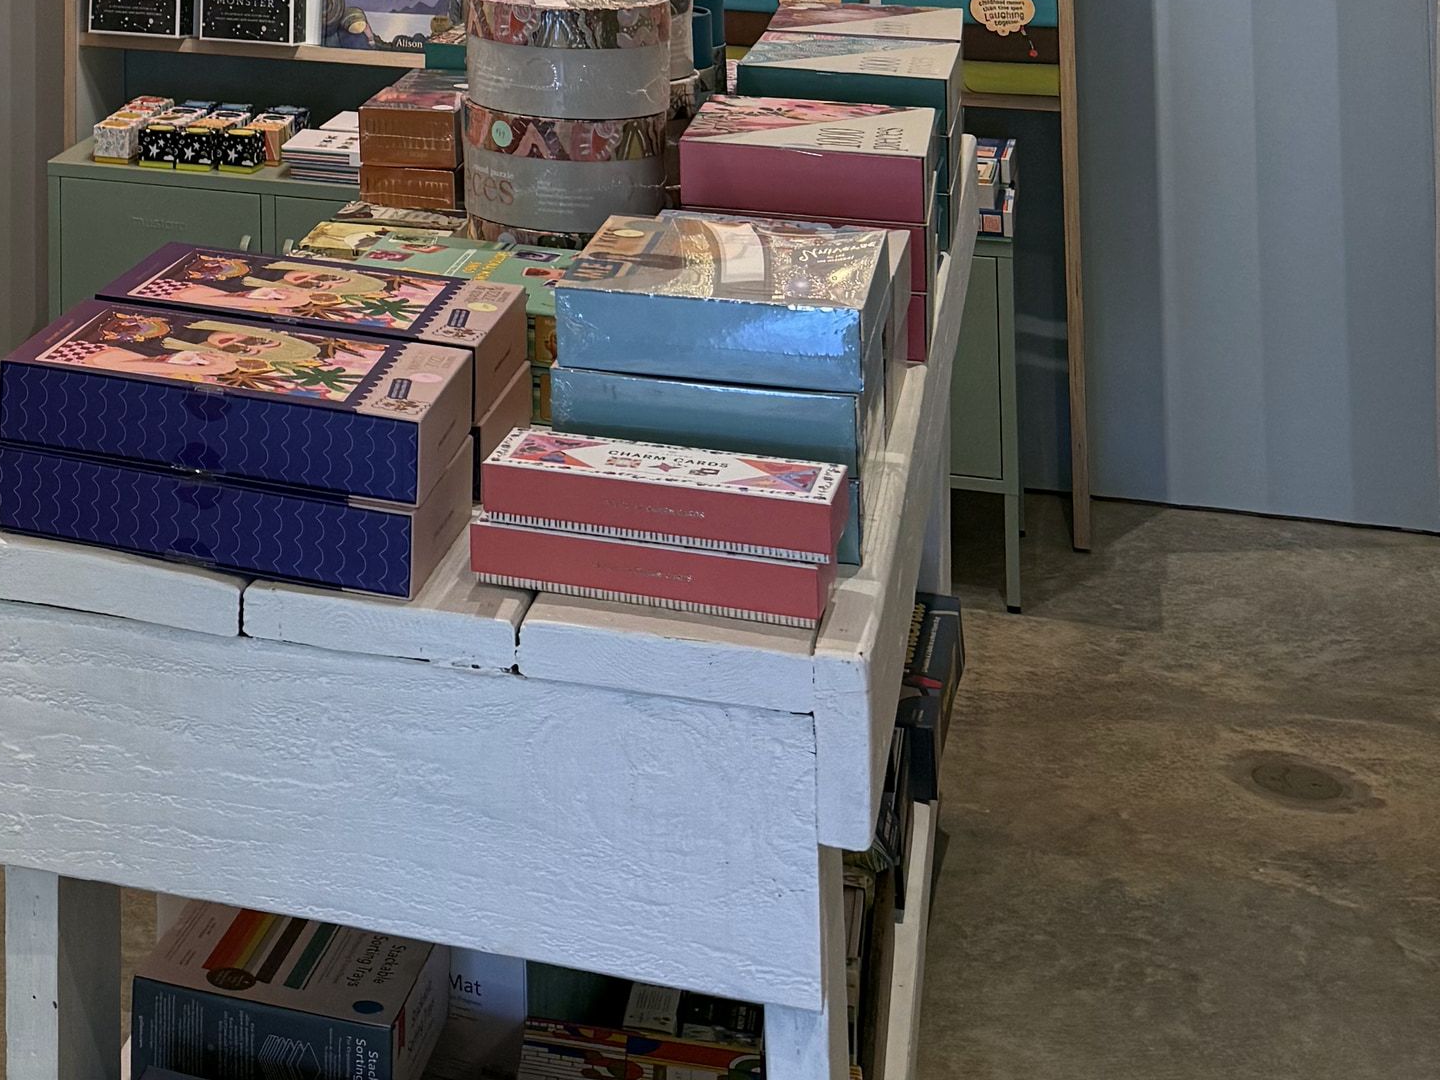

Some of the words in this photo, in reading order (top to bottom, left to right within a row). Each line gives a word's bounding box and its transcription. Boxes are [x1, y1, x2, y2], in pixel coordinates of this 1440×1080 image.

[396, 37, 424, 49] Alison
[608, 450, 666, 461] CHARM
[674, 458, 729, 468] CARDS
[373, 945, 407, 985] Stackable
